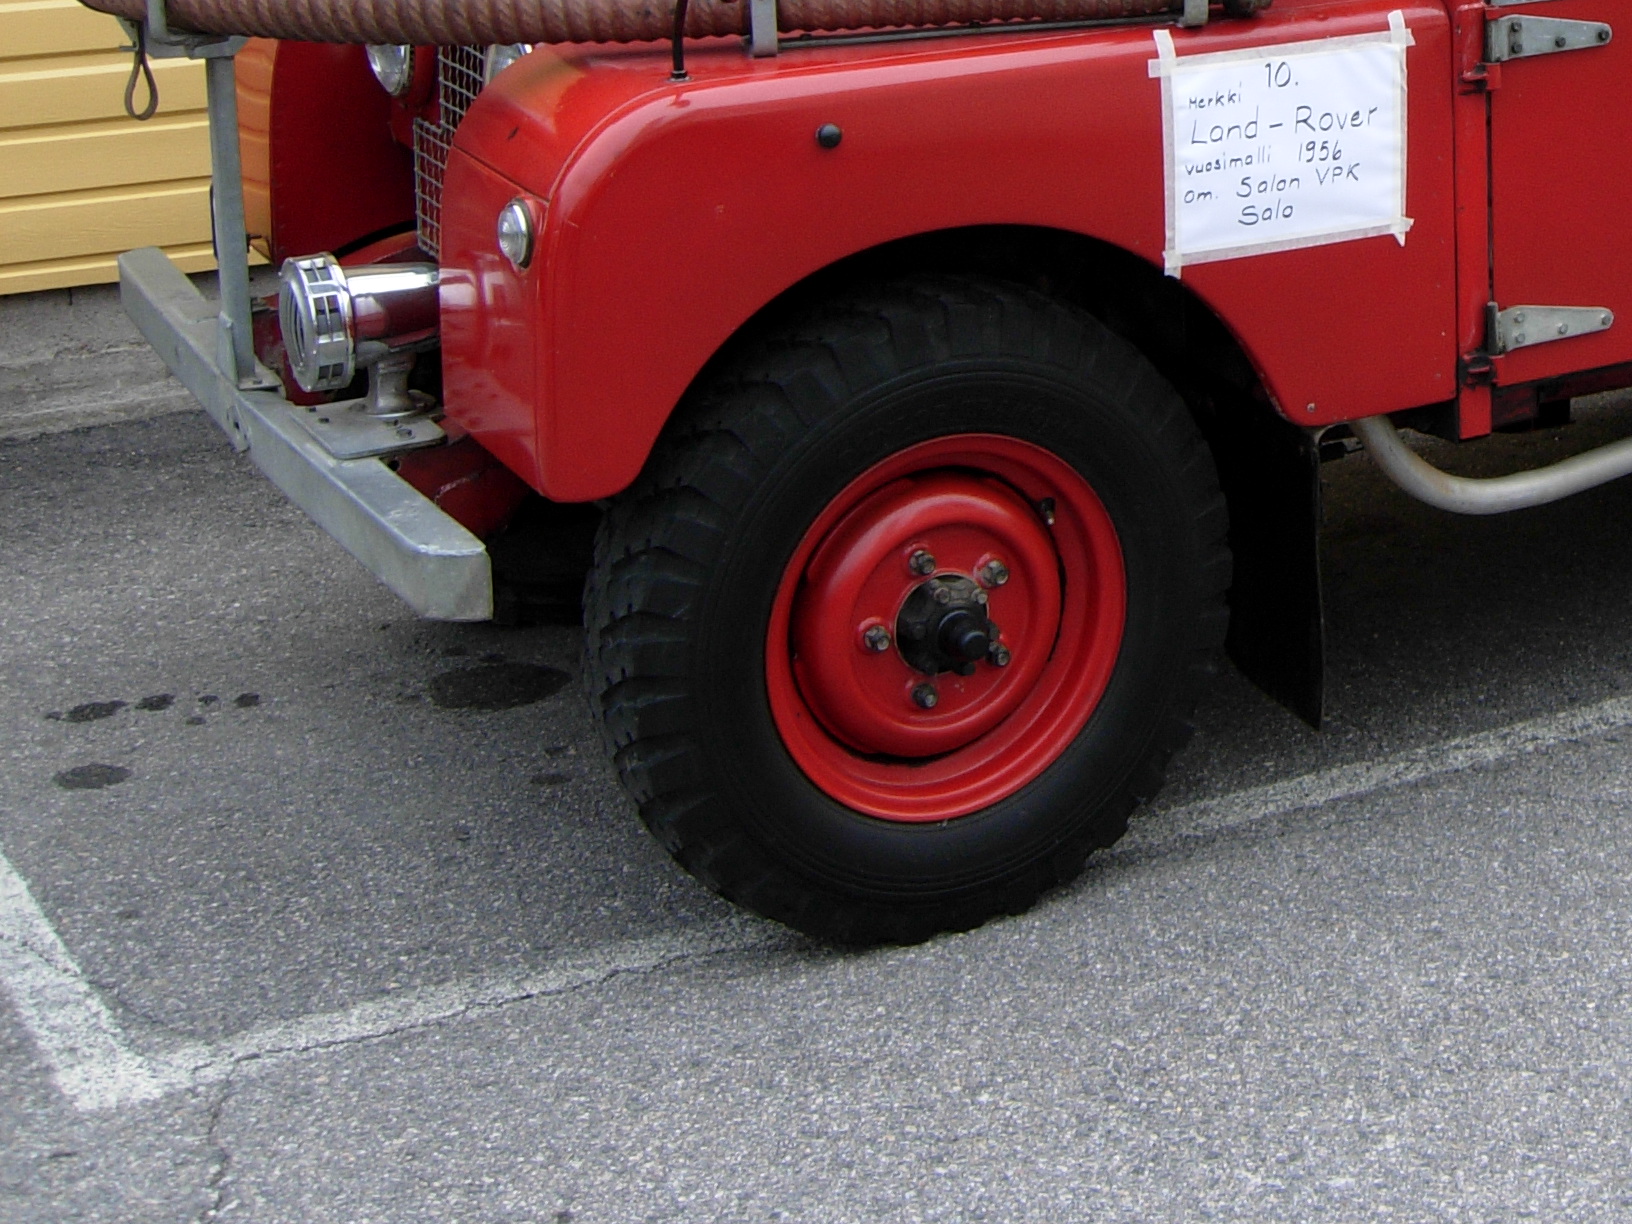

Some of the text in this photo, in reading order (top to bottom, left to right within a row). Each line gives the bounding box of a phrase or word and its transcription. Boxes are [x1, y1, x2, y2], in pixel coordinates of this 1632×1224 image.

[1297, 139, 1343, 164] 1956
[1235, 173, 1301, 199] Salon
[1314, 161, 1361, 187] VPK
[1237, 198, 1295, 226] Salo
